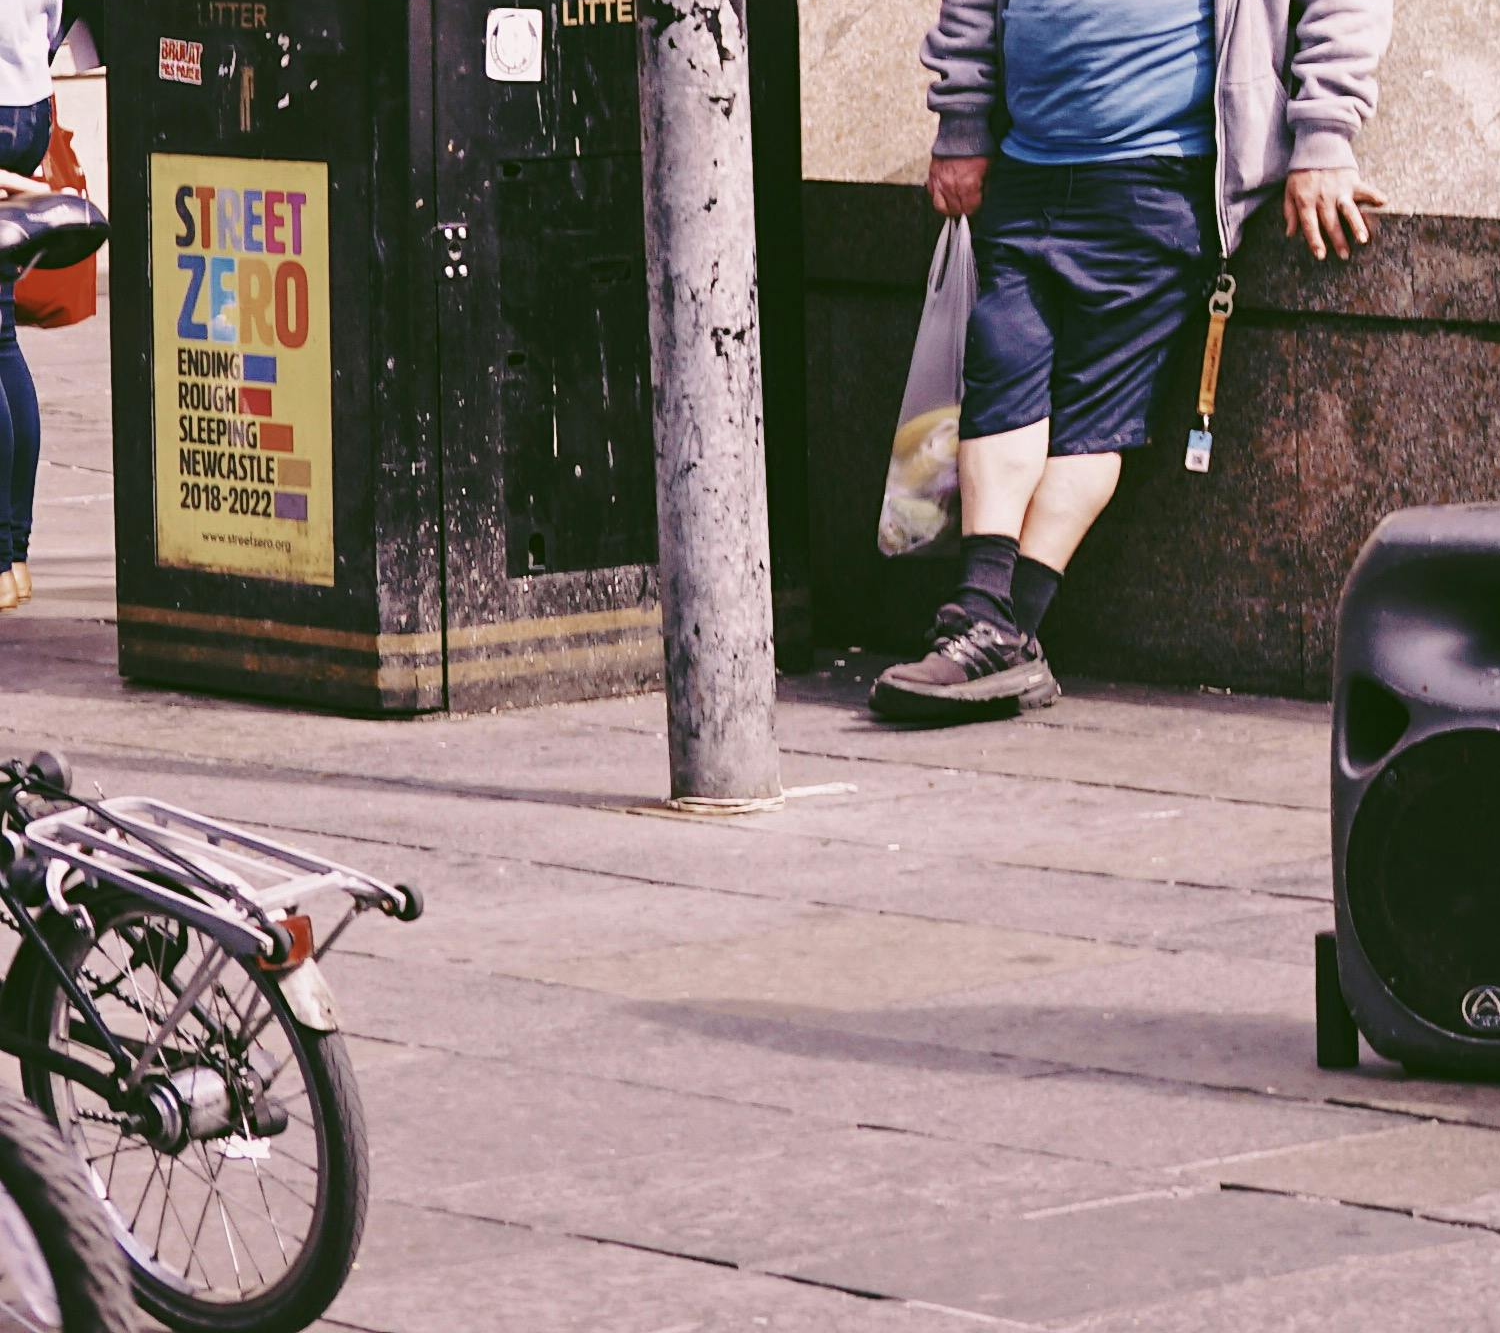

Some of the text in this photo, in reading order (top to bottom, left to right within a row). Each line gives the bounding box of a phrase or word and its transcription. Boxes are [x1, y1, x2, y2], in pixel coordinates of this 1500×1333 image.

[175, 185, 306, 255] STREET
[177, 254, 309, 349] ZERO
[177, 348, 240, 380] ENDING
[178, 381, 237, 414] ROUGH
[178, 414, 258, 448] SLEEPING
[179, 448, 275, 485] NEWCASTLE
[180, 482, 272, 518] 2018-2022
[202, 532, 292, 553] www.streetzero.org
